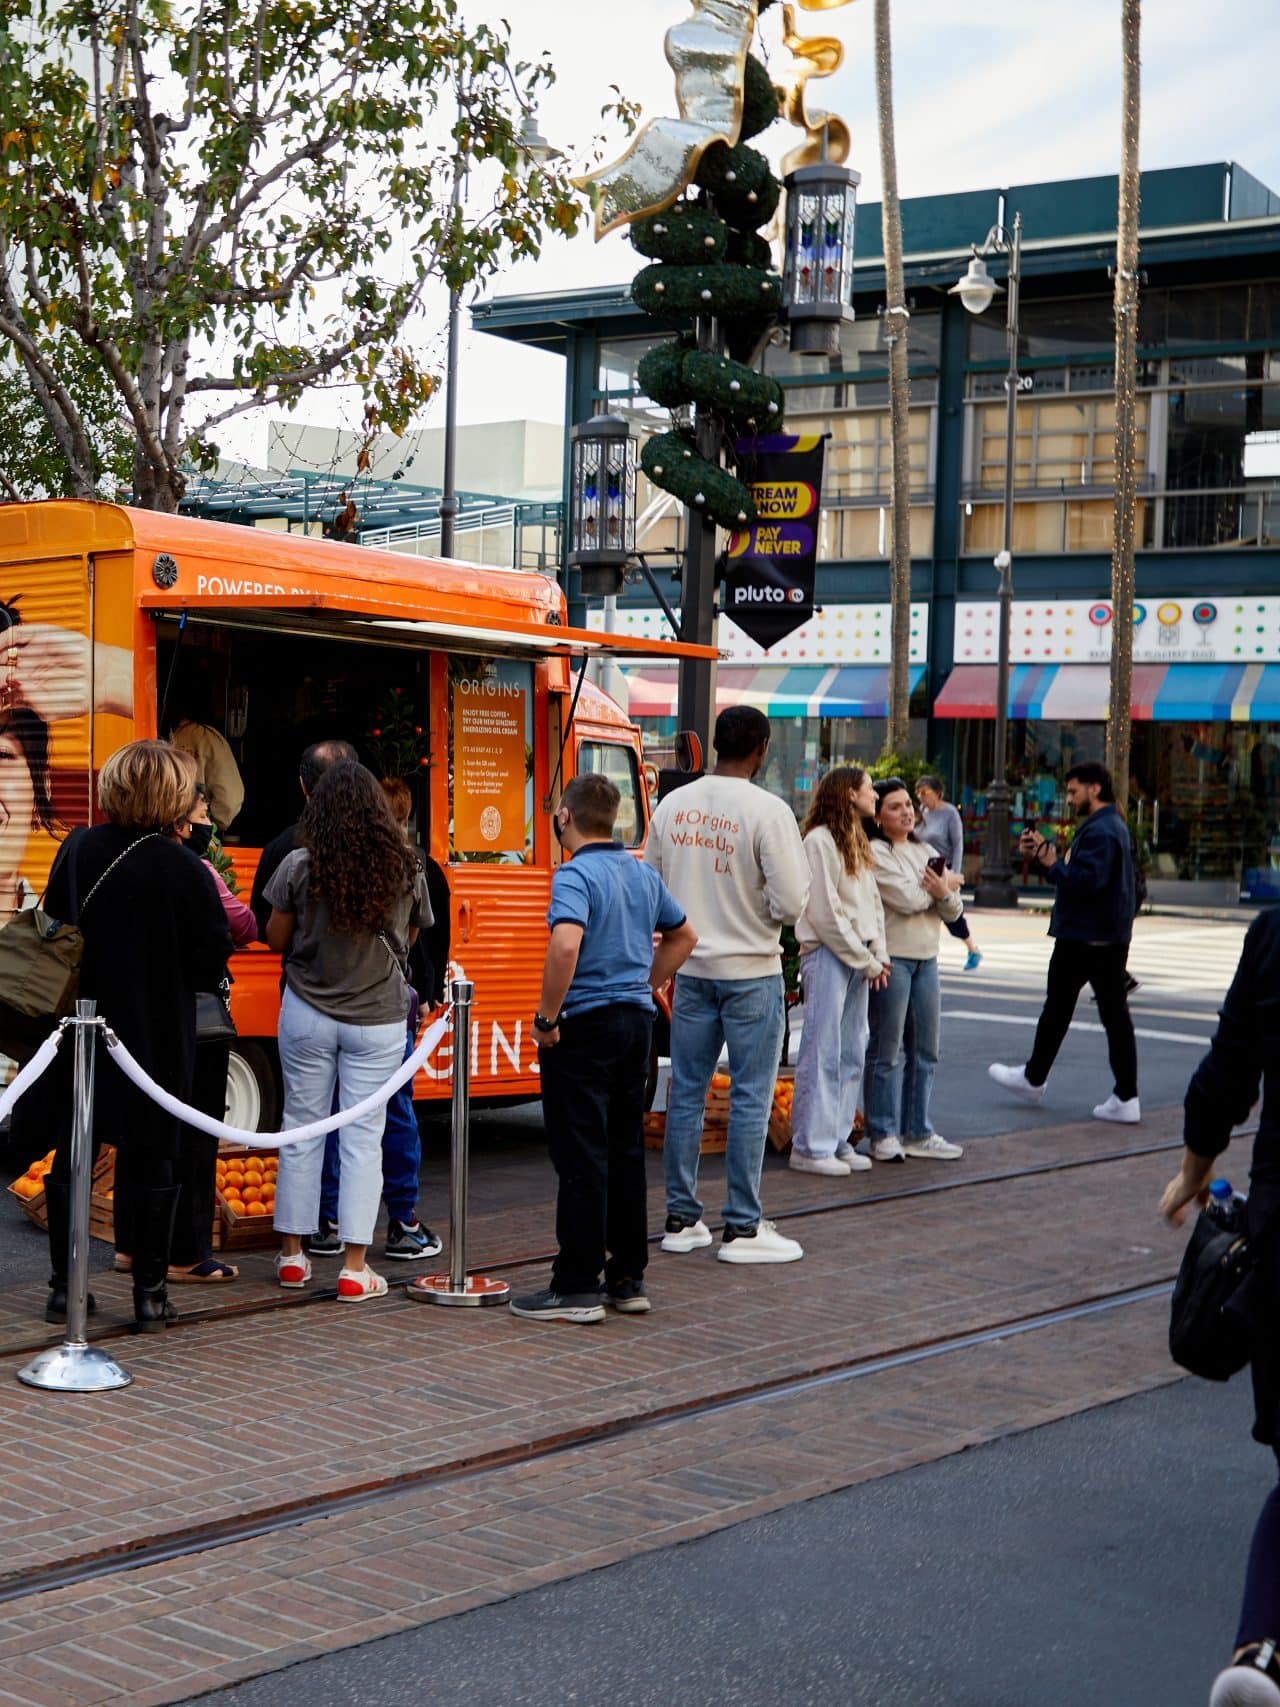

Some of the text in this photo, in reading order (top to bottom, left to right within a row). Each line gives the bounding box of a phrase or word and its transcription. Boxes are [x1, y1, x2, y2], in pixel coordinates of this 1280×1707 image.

[750, 487, 799, 500] TREAM
[760, 501, 797, 513] NOW
[756, 526, 781, 540] PAY
[754, 540, 802, 555] NEVER
[734, 585, 785, 605] pluto
[460, 678, 520, 698] ORIGINS
[674, 809, 739, 833] #Orgins
[715, 857, 732, 876] LA
